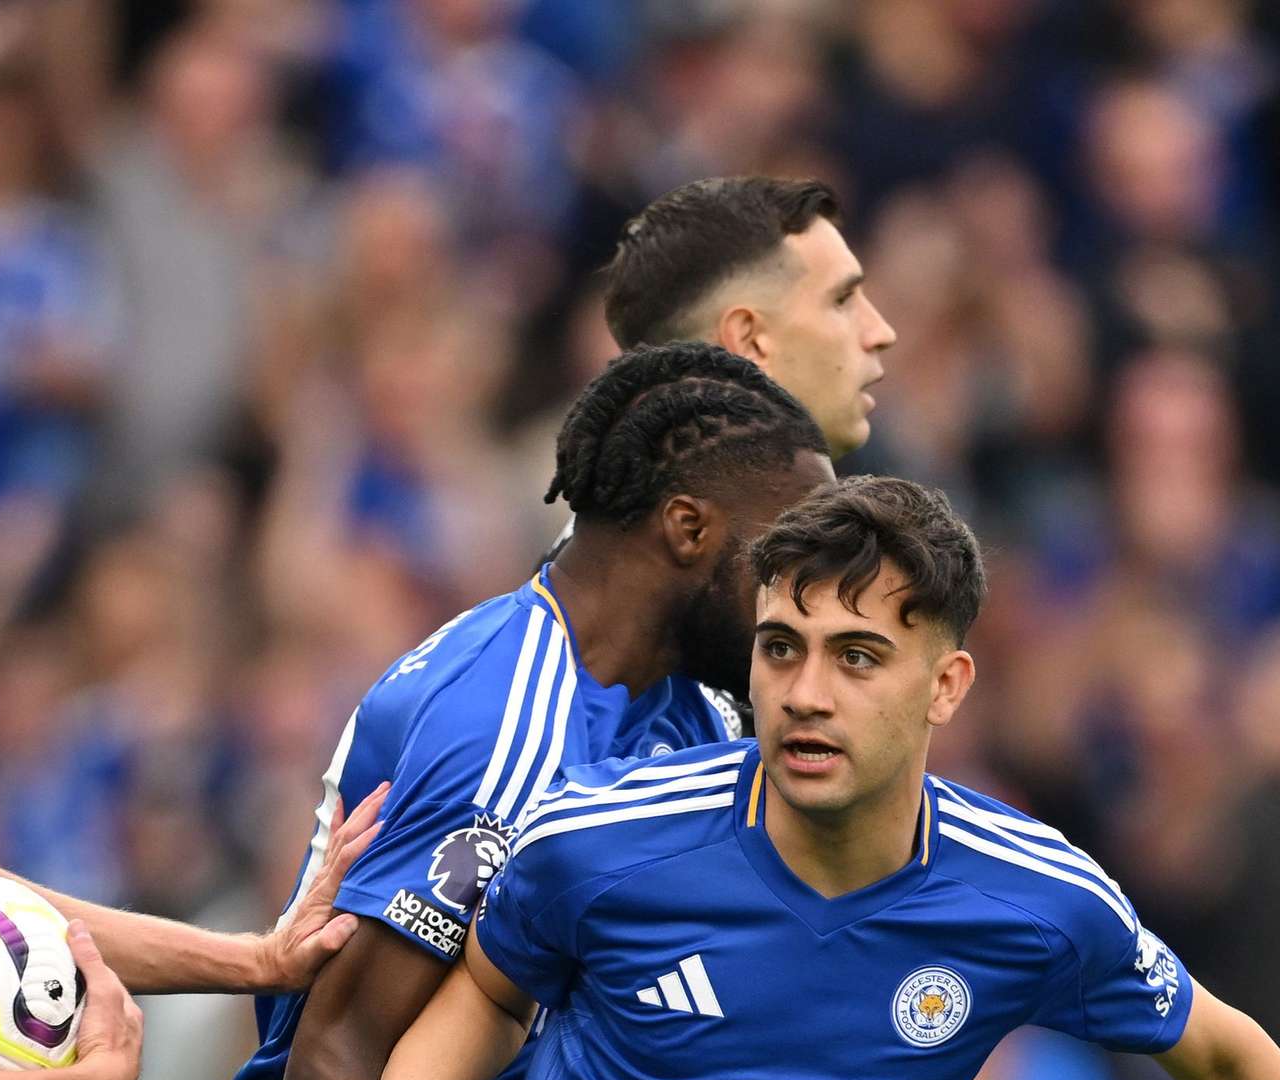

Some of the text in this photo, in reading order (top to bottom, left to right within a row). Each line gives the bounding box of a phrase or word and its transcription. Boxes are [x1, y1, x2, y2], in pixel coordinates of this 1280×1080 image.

[392, 888, 466, 942] No room
[410, 919, 461, 957] racism
[902, 975, 963, 1006] LEICESTER CITY
[900, 1010, 961, 1038] FOOTBALL CLUB
